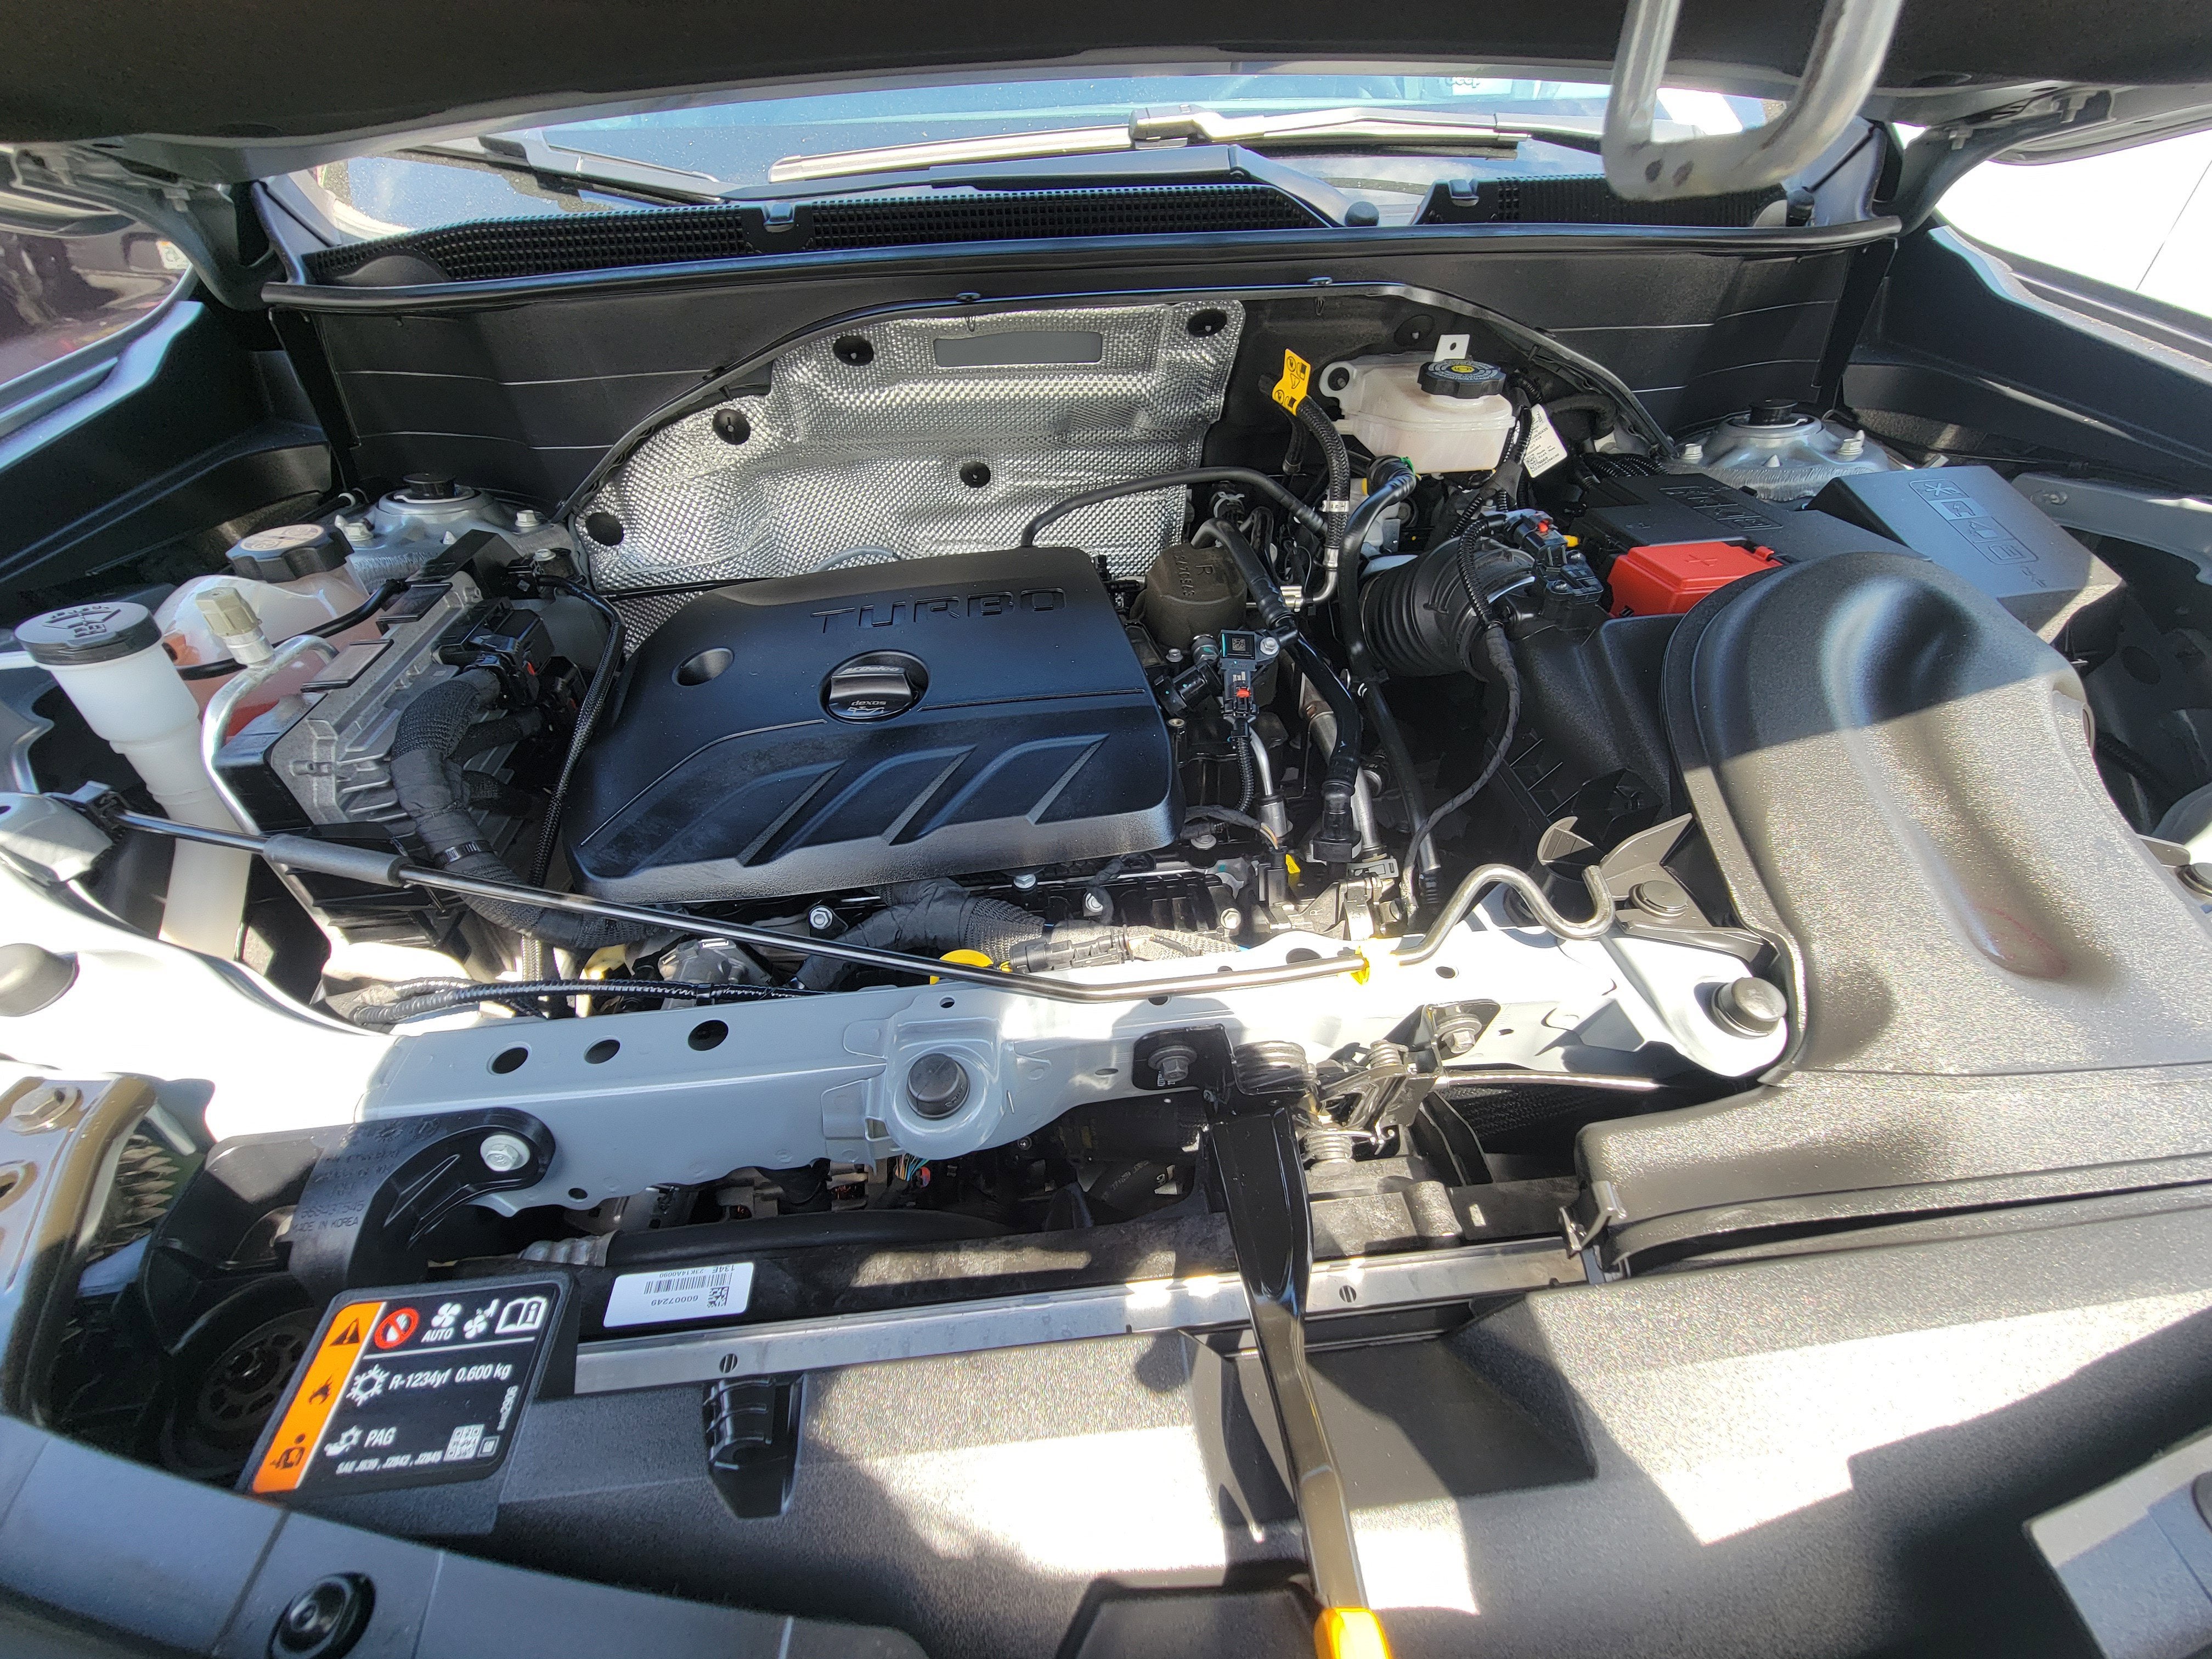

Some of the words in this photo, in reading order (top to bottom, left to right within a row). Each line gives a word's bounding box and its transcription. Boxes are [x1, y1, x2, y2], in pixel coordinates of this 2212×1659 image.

[810, 588, 1066, 634] TURBO
[331, 1216, 358, 1228] KOREA
[712, 1264, 736, 1274] 134F
[421, 1327, 455, 1343] AUTO
[388, 1367, 453, 1391] R-1234yf
[454, 1363, 494, 1383] 0.600
[494, 1362, 512, 1381] kg
[364, 1427, 397, 1446] PAG
